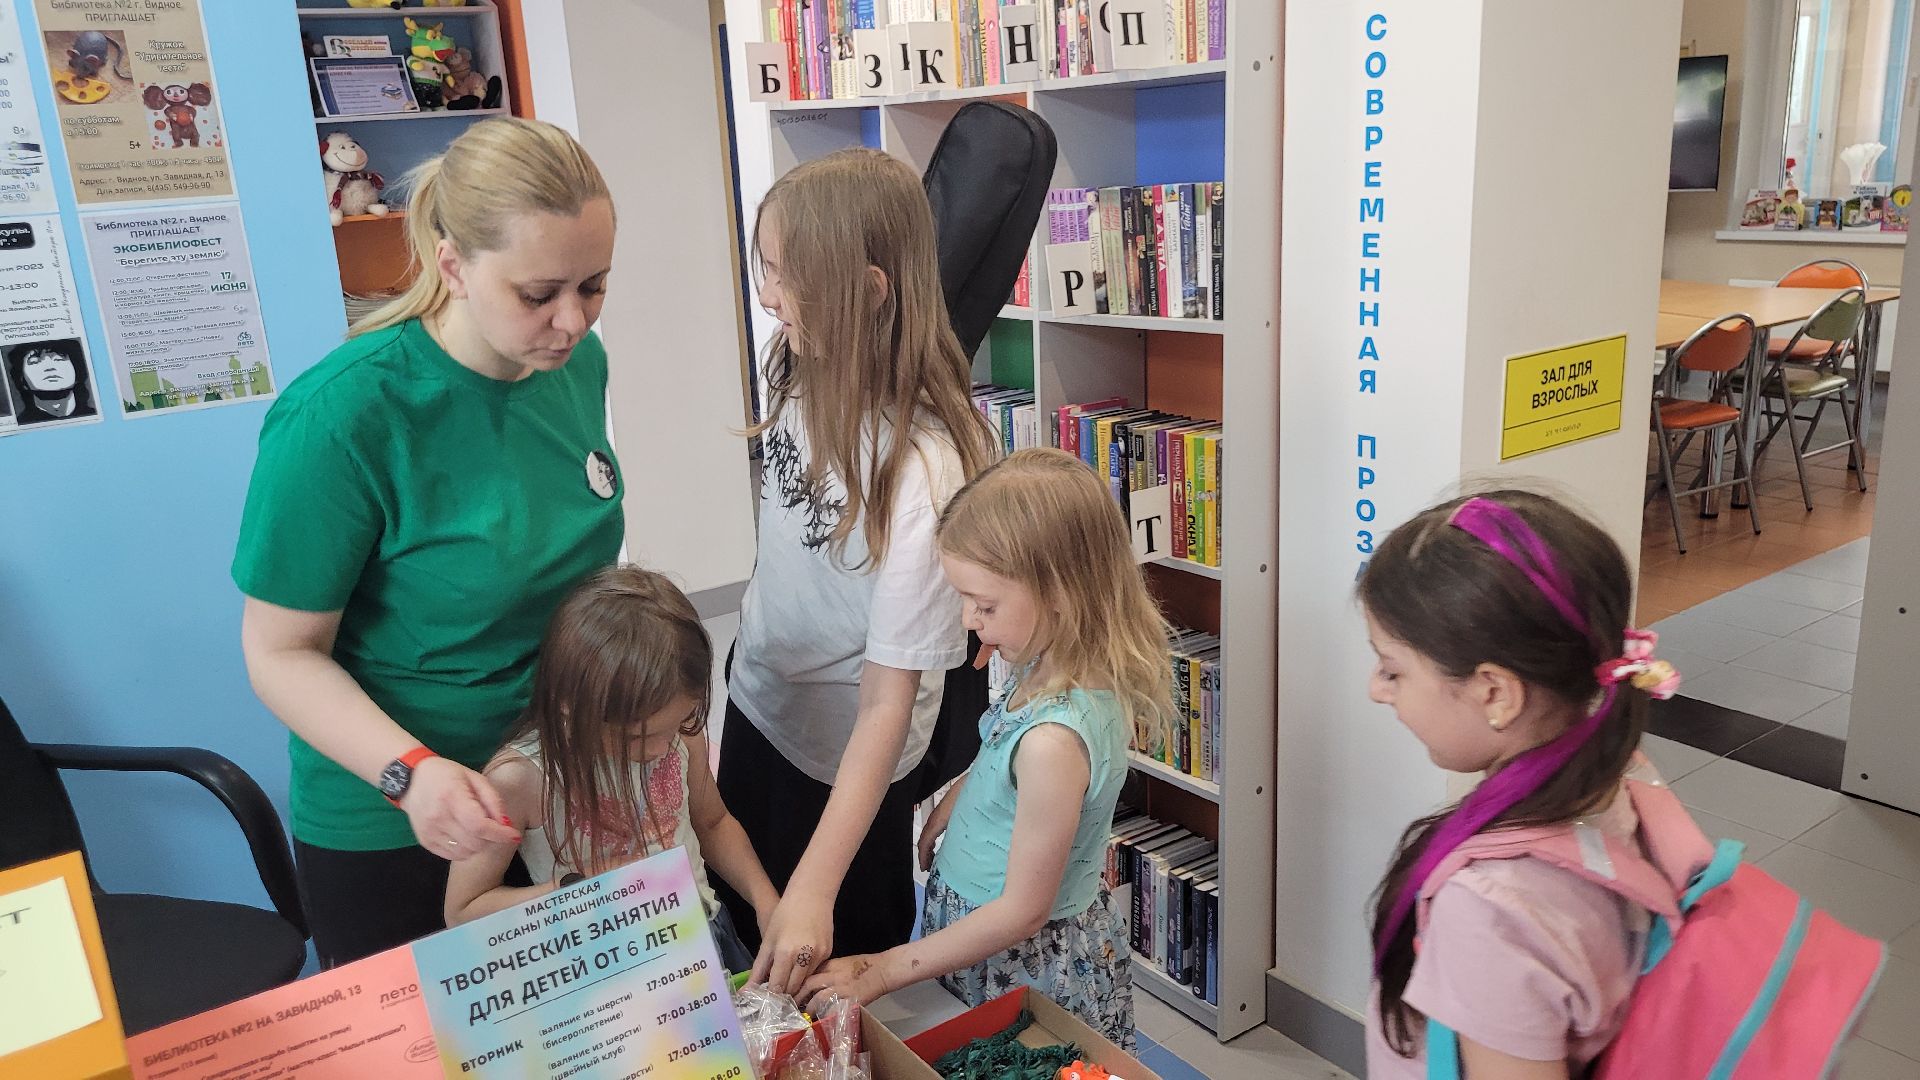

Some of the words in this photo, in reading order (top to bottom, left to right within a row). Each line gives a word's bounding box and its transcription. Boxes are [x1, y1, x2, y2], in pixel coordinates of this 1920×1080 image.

[85, 13, 156, 22] ПРИГЛАШАЕТ
[1117, 11, 1149, 46] П
[149, 40, 184, 50] Кружок
[1003, 23, 1038, 65] Н
[758, 63, 781, 94] Б
[864, 54, 883, 89] З
[916, 49, 946, 85] К
[78, 115, 120, 126] субботам
[129, 140, 141, 150] 5+
[215, 170, 224, 178] 13
[1357, 14, 1387, 394] СОВРЕМЕННАЯ
[96, 219, 158, 231] Библиотека
[160, 217, 177, 225] №2
[189, 214, 227, 223] Видное
[130, 226, 201, 238] ПРИГЛАШАЕТ
[113, 237, 222, 254] ЭКОБИБЛИОФЕСТ
[115, 255, 168, 267] "Берегите
[171, 253, 187, 263] эту
[189, 249, 225, 260] землю"
[16, 263, 44, 271] 2023
[220, 271, 231, 280] 17
[210, 281, 247, 293] ИЮНЯ
[1059, 270, 1084, 308] Р
[1541, 366, 1565, 385] ЗАЛ
[1568, 359, 1593, 382] ДЛЯ
[1531, 379, 1599, 410] ВЗРОСЛЫХ
[1136, 515, 1161, 556] Т
[1187, 514, 1196, 547] ОКНА
[488, 920, 541, 947] ОКСАНЫ
[543, 878, 645, 926] КАЛАШНИКОВОЙ
[525, 881, 601, 917] МАСТЕРСКАЯ
[440, 929, 583, 997] ТВОРЧЕСКИЕ
[587, 891, 681, 941] ЗАНЯТИЯ
[468, 989, 515, 1026] ДЛЯ
[521, 955, 589, 1005] ДЕТЕЙ
[594, 946, 620, 970] ОТ
[627, 940, 639, 957] 6
[645, 923, 678, 951] ЛЕТ
[646, 959, 708, 992] 17:00-18:00
[380, 983, 418, 1003] лето
[656, 992, 718, 1026] 17:00-18:00
[143, 1030, 230, 1067] БИБЛИОТЕКА
[231, 1021, 253, 1038] №2
[256, 1015, 273, 1029] НА
[276, 989, 347, 1022] ЗАВИДНОЙ,
[348, 984, 363, 997] 13
[538, 1014, 581, 1037] (валяние
[583, 1009, 594, 1018] из
[597, 991, 633, 1013] шерсти)
[542, 1010, 624, 1050] (бисероплетение)
[461, 1039, 524, 1073] ВТОРНИК
[547, 1047, 591, 1071] (валяние
[593, 1042, 604, 1051] из
[606, 1024, 642, 1046] шерсти)
[601, 1045, 626, 1063] клуб)
[667, 1028, 729, 1064] 17:00-18:00
